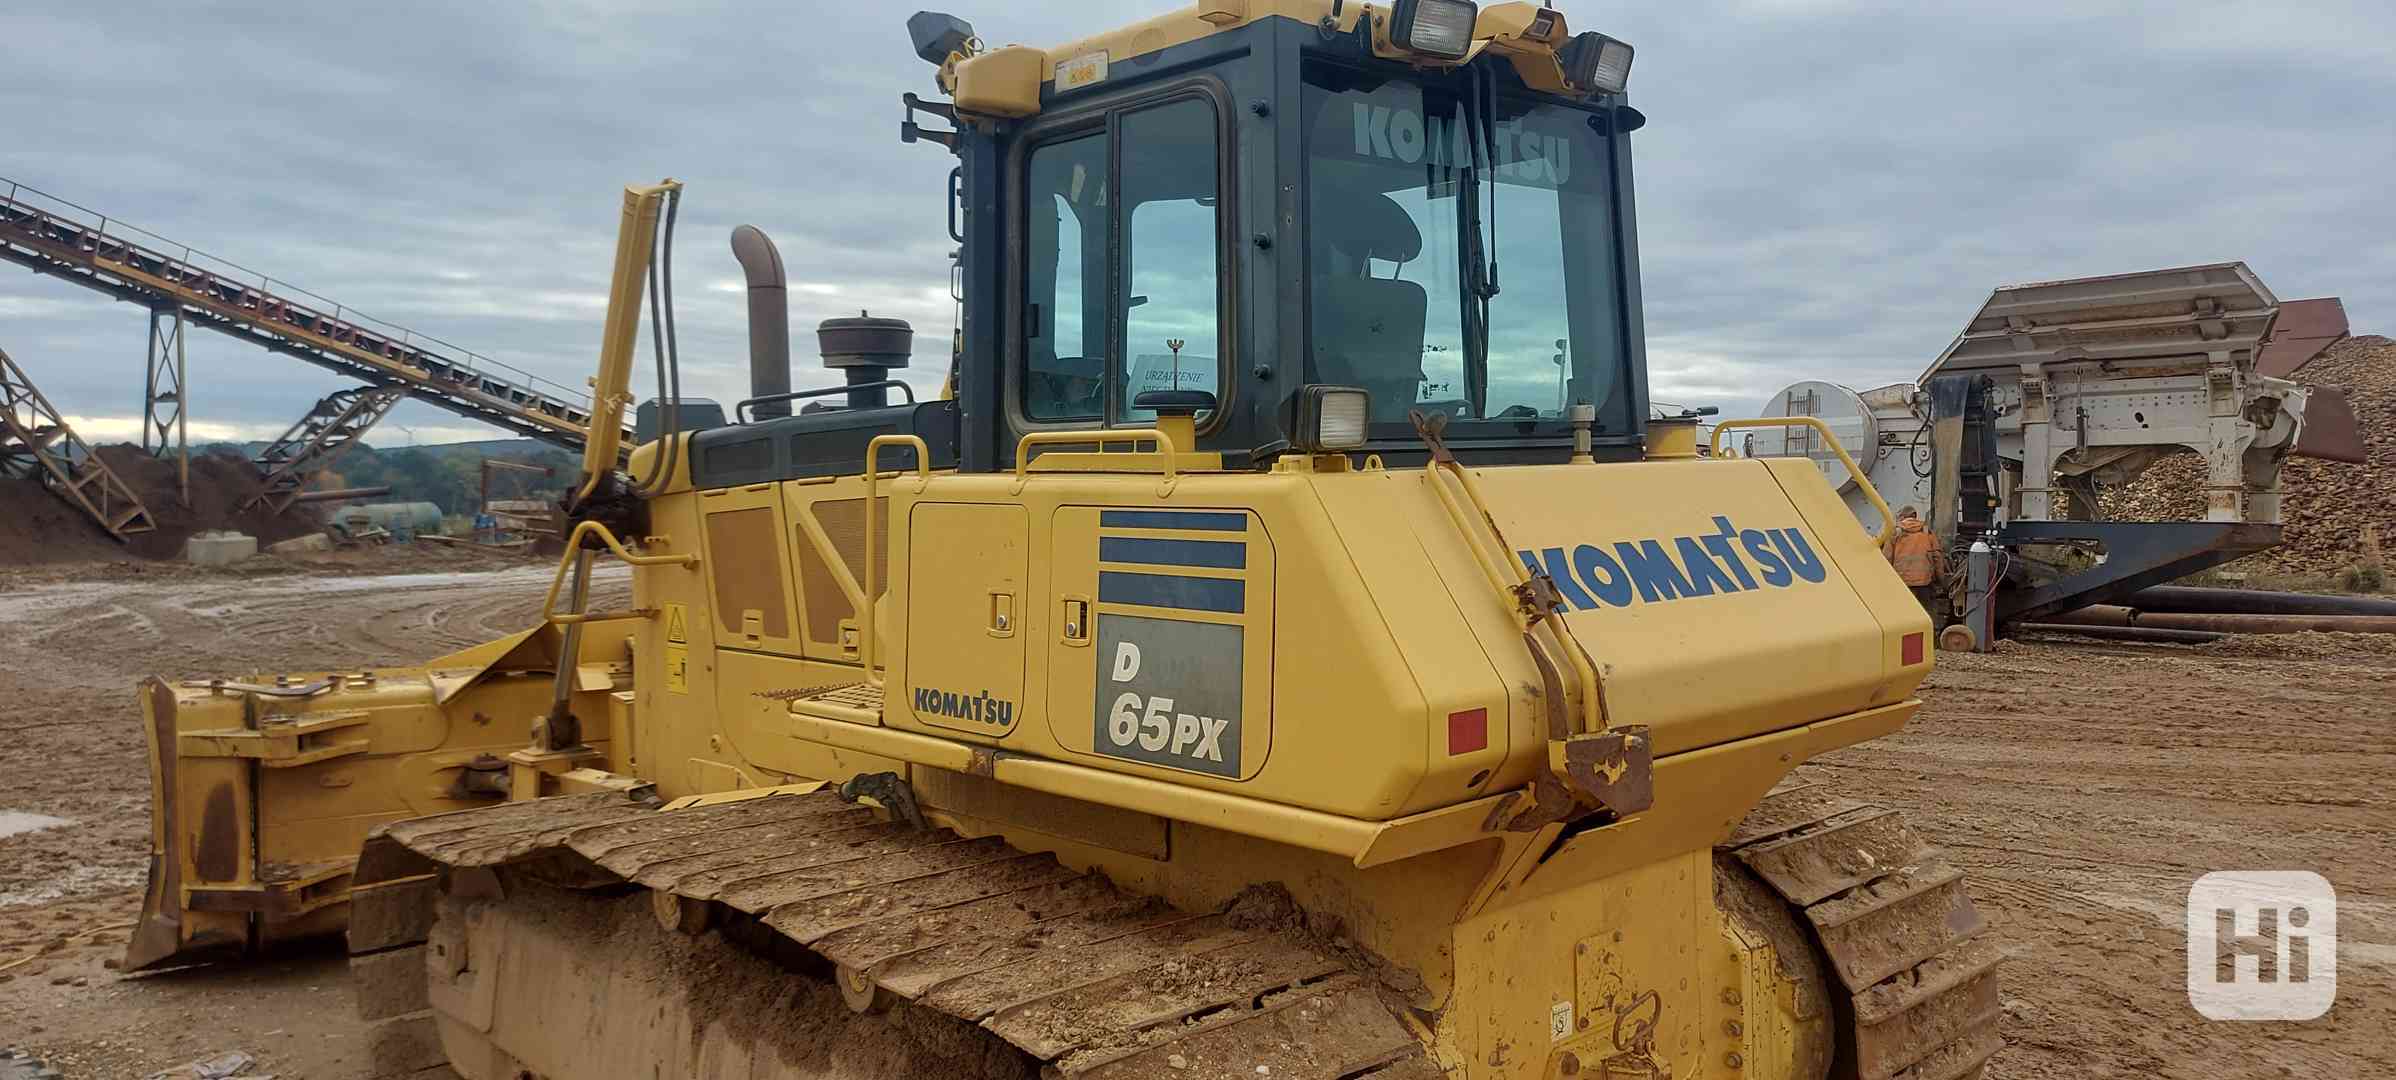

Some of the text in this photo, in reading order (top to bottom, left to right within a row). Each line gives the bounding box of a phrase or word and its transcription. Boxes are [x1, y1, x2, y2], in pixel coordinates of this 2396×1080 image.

[1517, 515, 1827, 614] KOMATSU
[1111, 641, 1141, 683] D
[914, 687, 1013, 726] KOMATSU
[1108, 692, 1229, 762] 65PX
